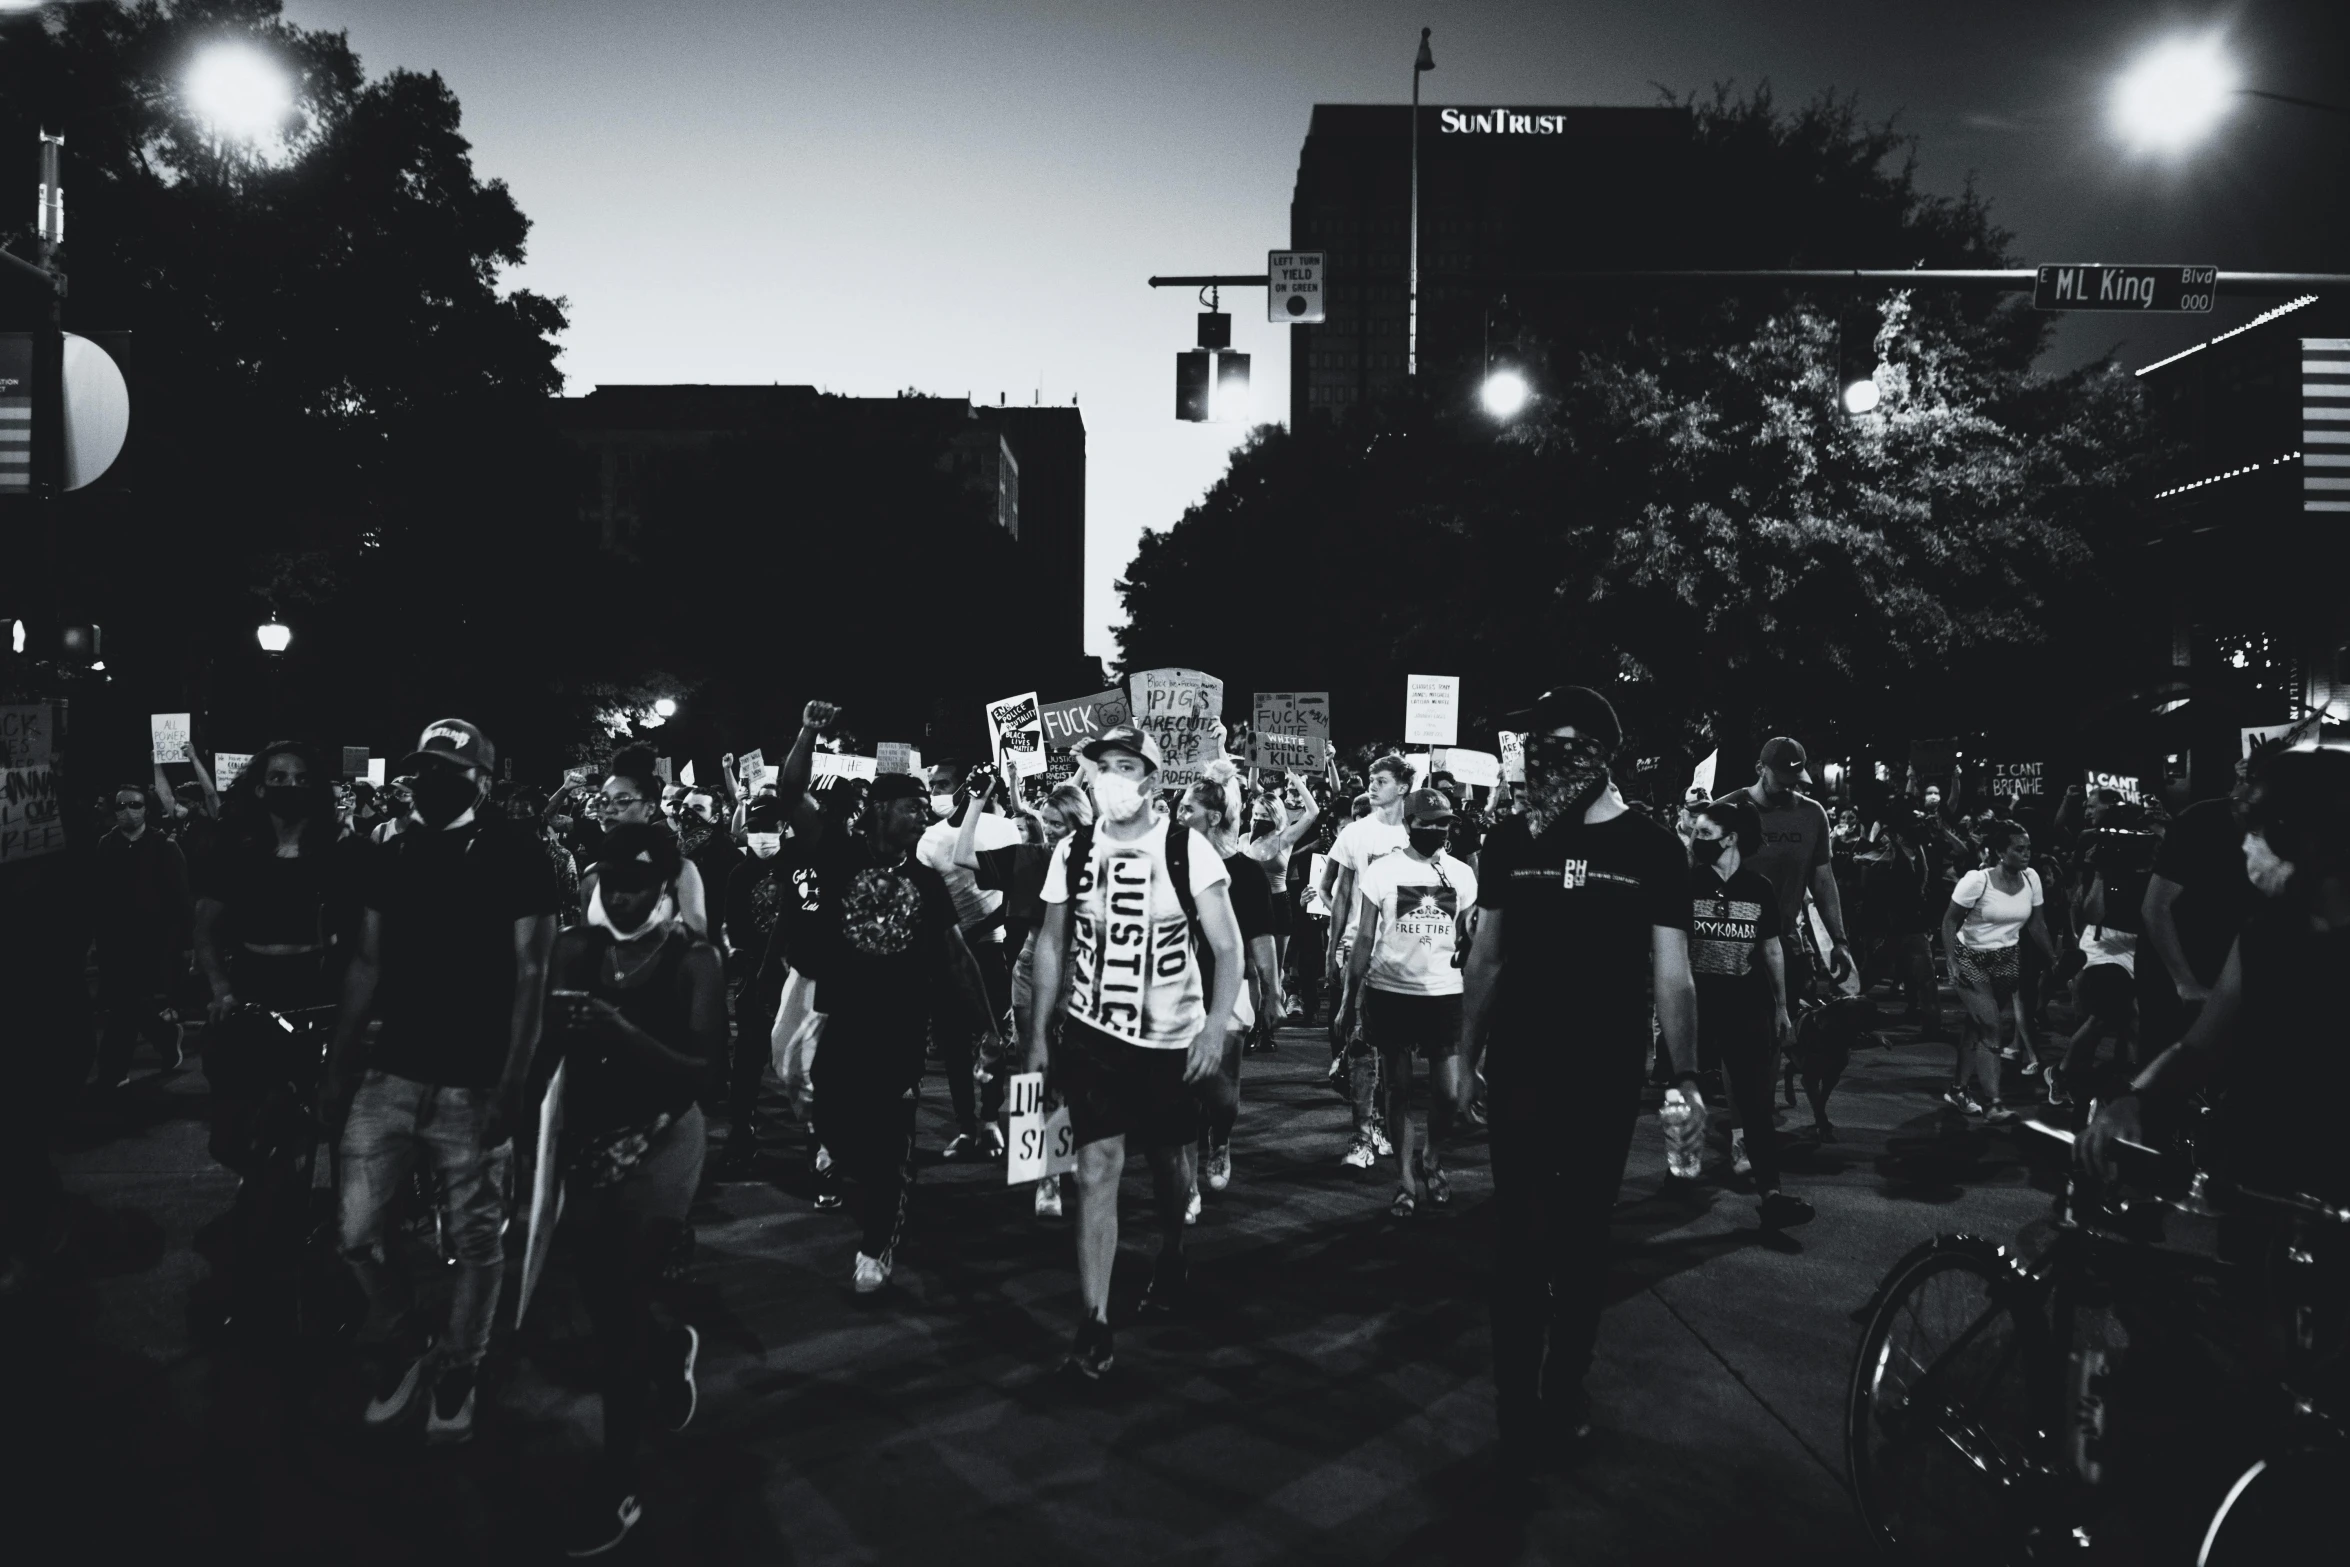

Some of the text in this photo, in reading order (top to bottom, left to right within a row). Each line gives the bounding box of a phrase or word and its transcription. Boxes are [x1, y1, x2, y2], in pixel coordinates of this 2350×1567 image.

[1273, 256, 1320, 266] LEFT TURN
[1282, 268, 1312, 280] YIELD
[1275, 283, 1318, 292] ON GREEN
[2040, 268, 2214, 309] E ML King Blvd
[2181, 294, 2210, 310] 000
[1002, 703, 1027, 723] POLICE
[1258, 710, 1308, 724] FUCK
[164, 720, 177, 730] ALL
[1006, 709, 1036, 730] BRUTALITY
[1044, 705, 1099, 739] FUCK
[154, 731, 187, 741] POWER
[1006, 731, 1026, 740] BLACK
[1266, 733, 1306, 745] WHITE
[1502, 734, 1510, 744] IF
[1263, 742, 1309, 753] SILENCE
[1503, 743, 1518, 753] ARE
[1050, 764, 1071, 772] PEACE
[1996, 762, 2044, 776] I CANT
[2088, 768, 2139, 792] I CANT
[1993, 777, 2045, 796] BREATHE
[1396, 923, 1452, 935] FREE TIBE
[1156, 920, 1187, 977] NO
